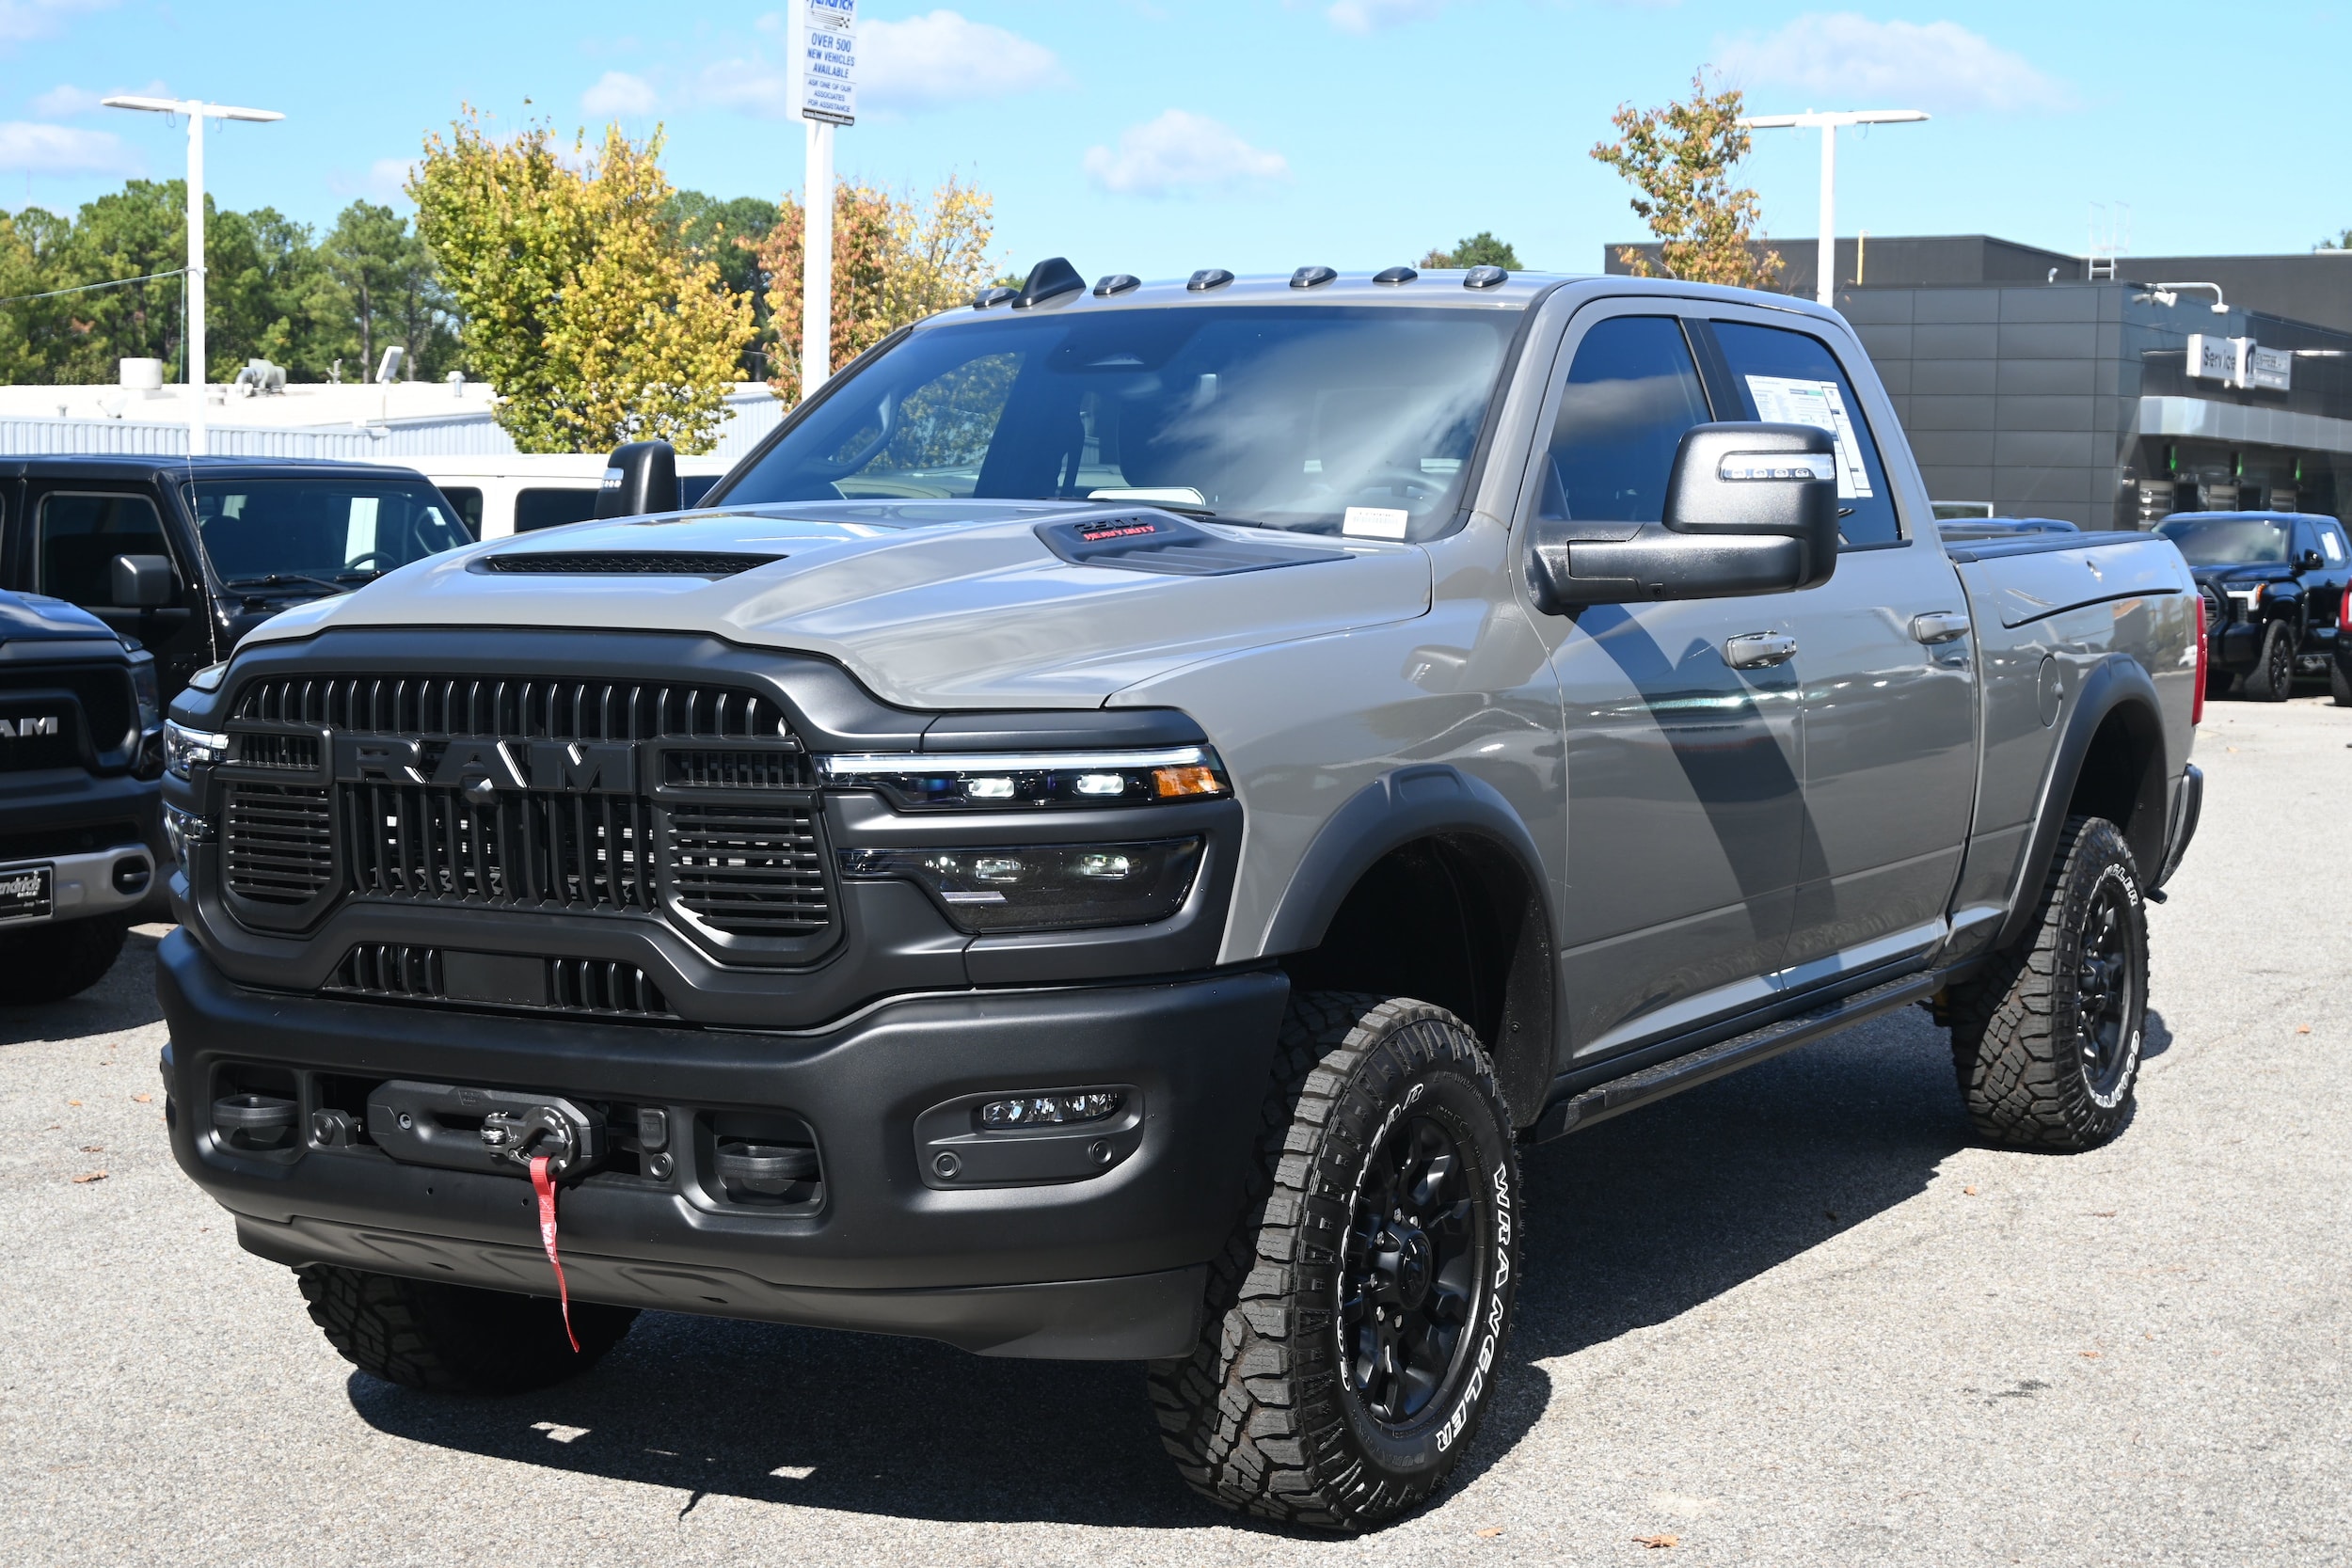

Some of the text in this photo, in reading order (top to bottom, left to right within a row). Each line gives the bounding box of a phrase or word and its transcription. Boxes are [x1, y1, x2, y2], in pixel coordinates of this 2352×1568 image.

[811, 32, 851, 53] OVER 500
[807, 48, 855, 67] NEW VEHICLES
[813, 62, 850, 78] AVAILABLE
[807, 98, 850, 113] FOR ASSISTANCE
[814, 90, 845, 102] ASSOCIATES
[2203, 345, 2235, 372] Service
[1073, 517, 1148, 533] 2500
[1084, 526, 1155, 541] HEAVY DUTY
[0, 717, 58, 737] AM
[333, 736, 636, 794] RAM
[1438, 1162, 1511, 1451] WRANGLER
